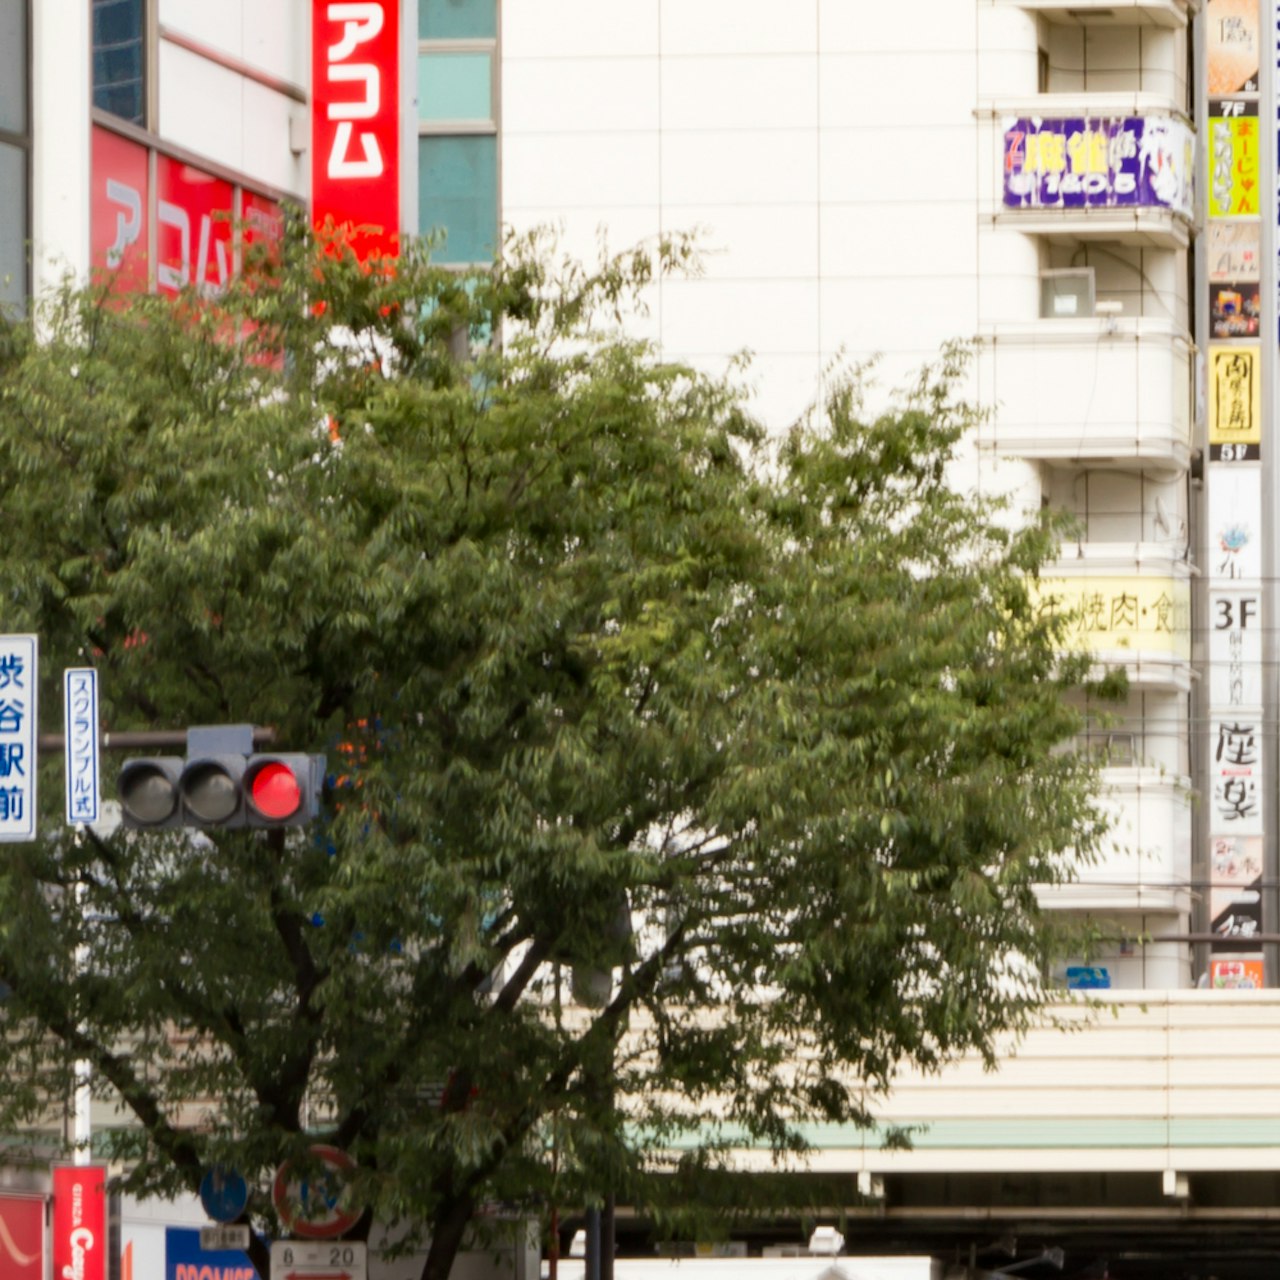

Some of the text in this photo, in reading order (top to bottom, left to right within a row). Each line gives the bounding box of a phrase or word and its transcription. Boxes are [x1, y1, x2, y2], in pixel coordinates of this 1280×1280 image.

[327, 3, 385, 179] アコム
[1220, 101, 1246, 117] 7F
[107, 178, 230, 300] アコム
[1215, 599, 1257, 630] 3F
[0, 654, 25, 821] 渋谷駅前
[72, 1183, 83, 1228] GINZA
[284, 1247, 294, 1266] 8
[330, 1247, 354, 1265] 20
